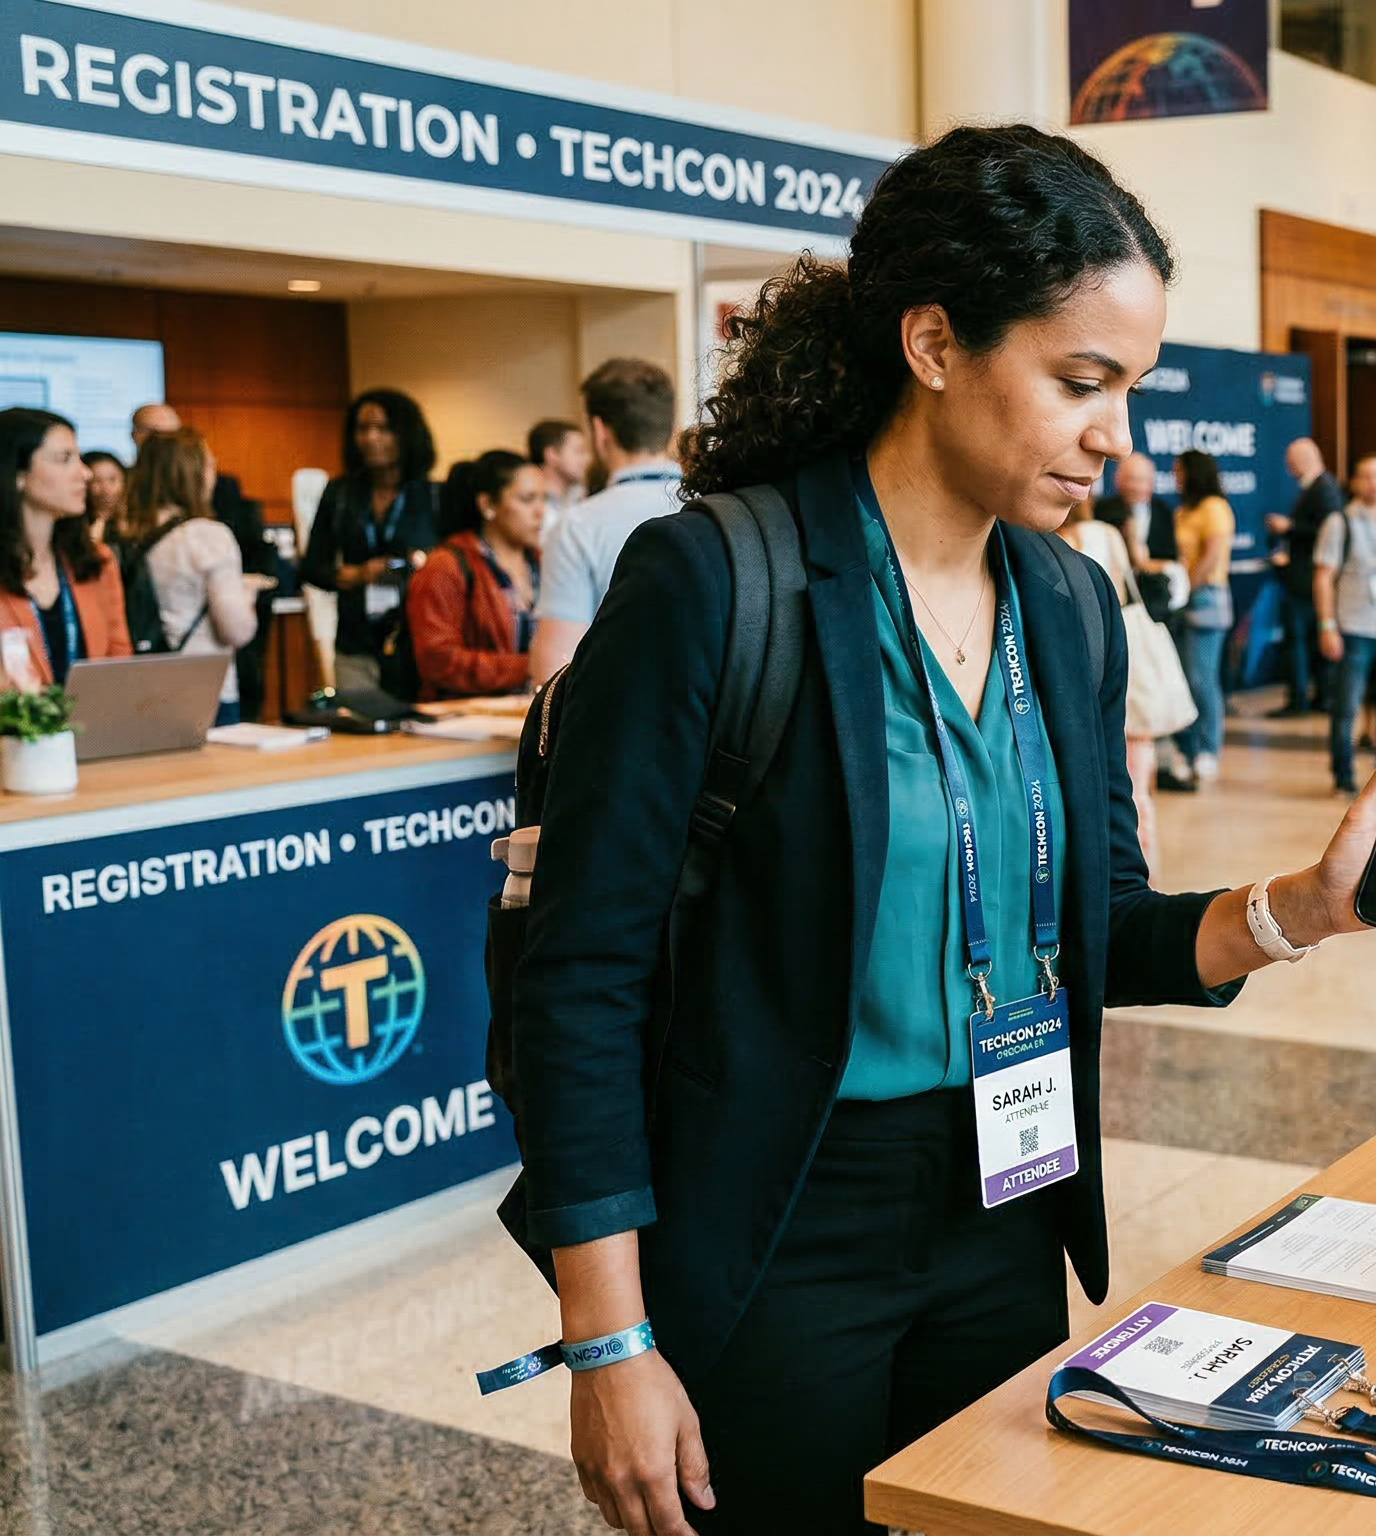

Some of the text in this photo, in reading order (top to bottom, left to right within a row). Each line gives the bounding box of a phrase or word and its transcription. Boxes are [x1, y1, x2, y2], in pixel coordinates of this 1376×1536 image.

[19, 33, 865, 219] REGISTRATION TECHCON 2024
[41, 797, 516, 915] REGISTRATION TECHCON
[979, 1024, 1034, 1054] TECHCON
[1035, 1017, 1062, 1037] 2024
[992, 1077, 1057, 1111] SARAH J.
[218, 1080, 496, 1212] WELCOME
[1002, 1157, 1061, 1192] ATTENDEE
[1201, 1335, 1254, 1375] SARAH
[1264, 1438, 1328, 1452] TECHCON
